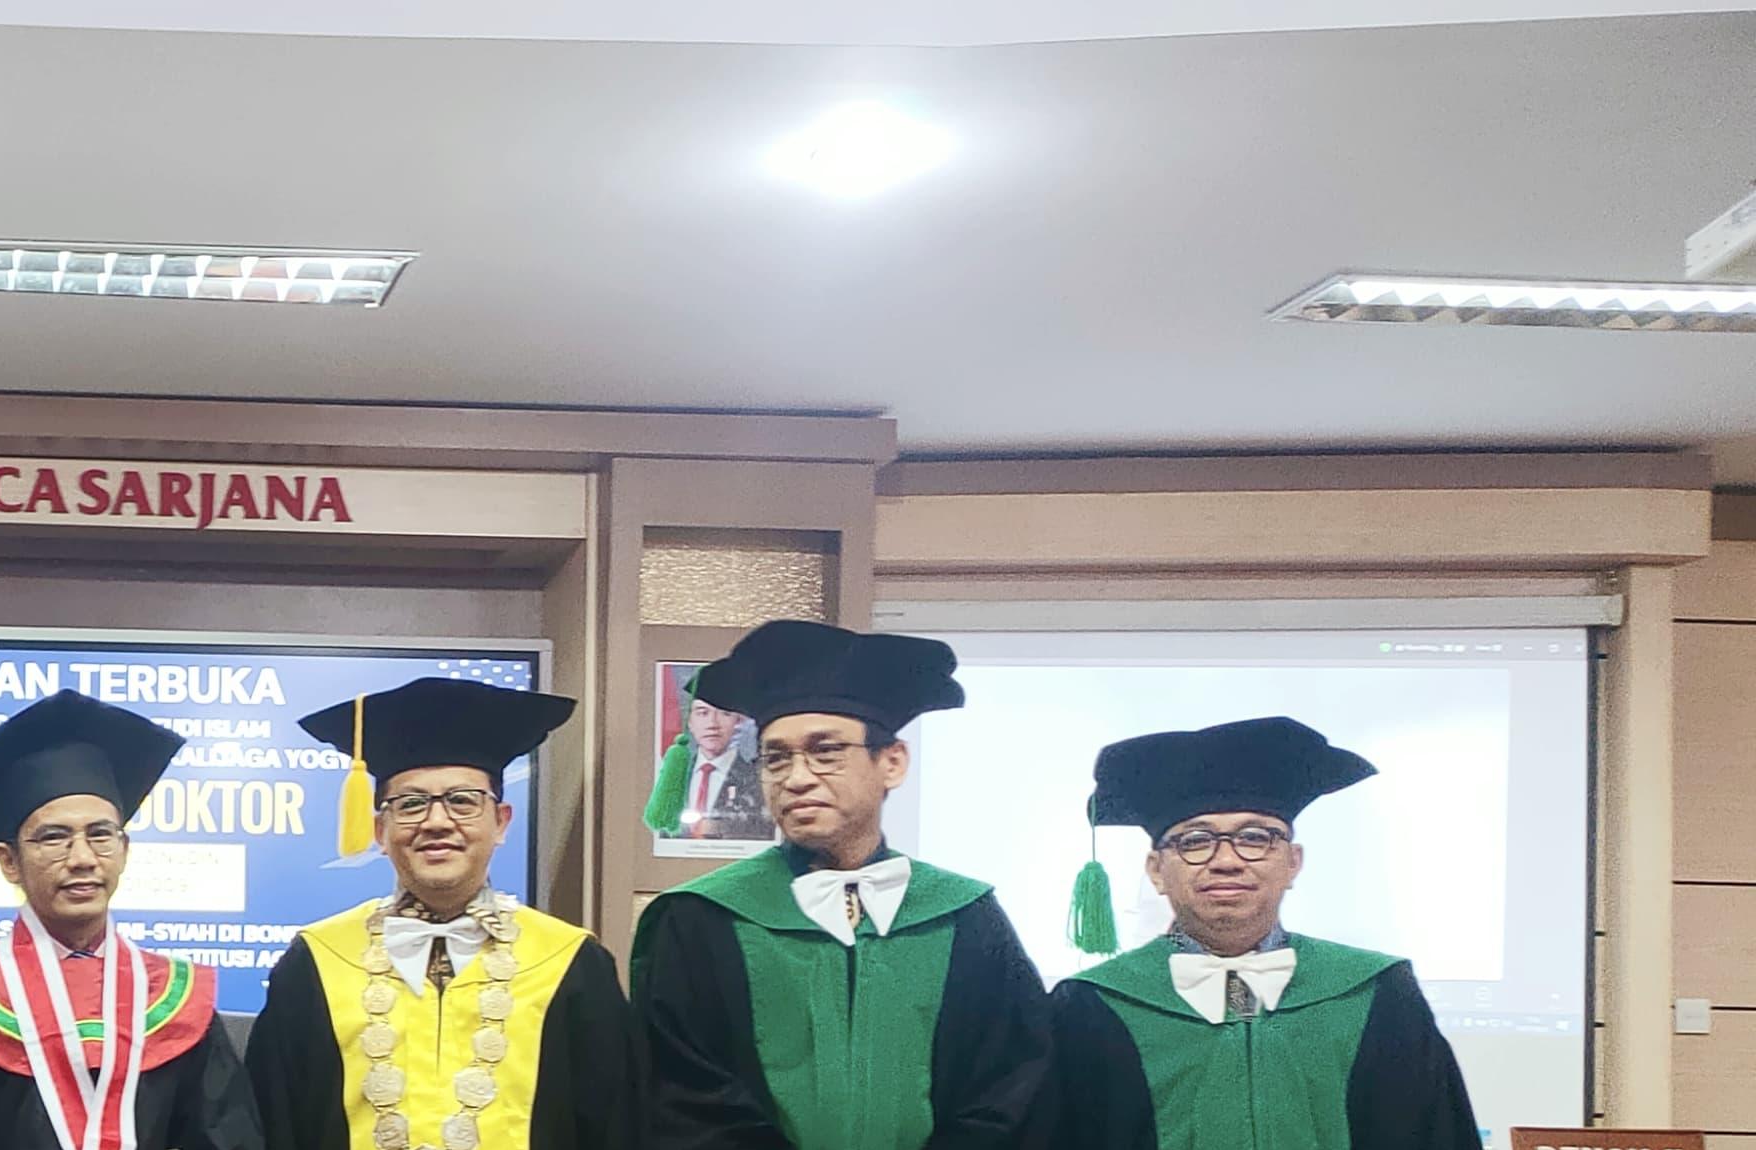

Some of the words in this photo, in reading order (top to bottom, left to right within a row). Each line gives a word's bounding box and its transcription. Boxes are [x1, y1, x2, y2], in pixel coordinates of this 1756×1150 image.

[77, 468, 353, 532] SARJANA
[70, 662, 287, 706] TERBUKA
[204, 719, 272, 739] ISLAM
